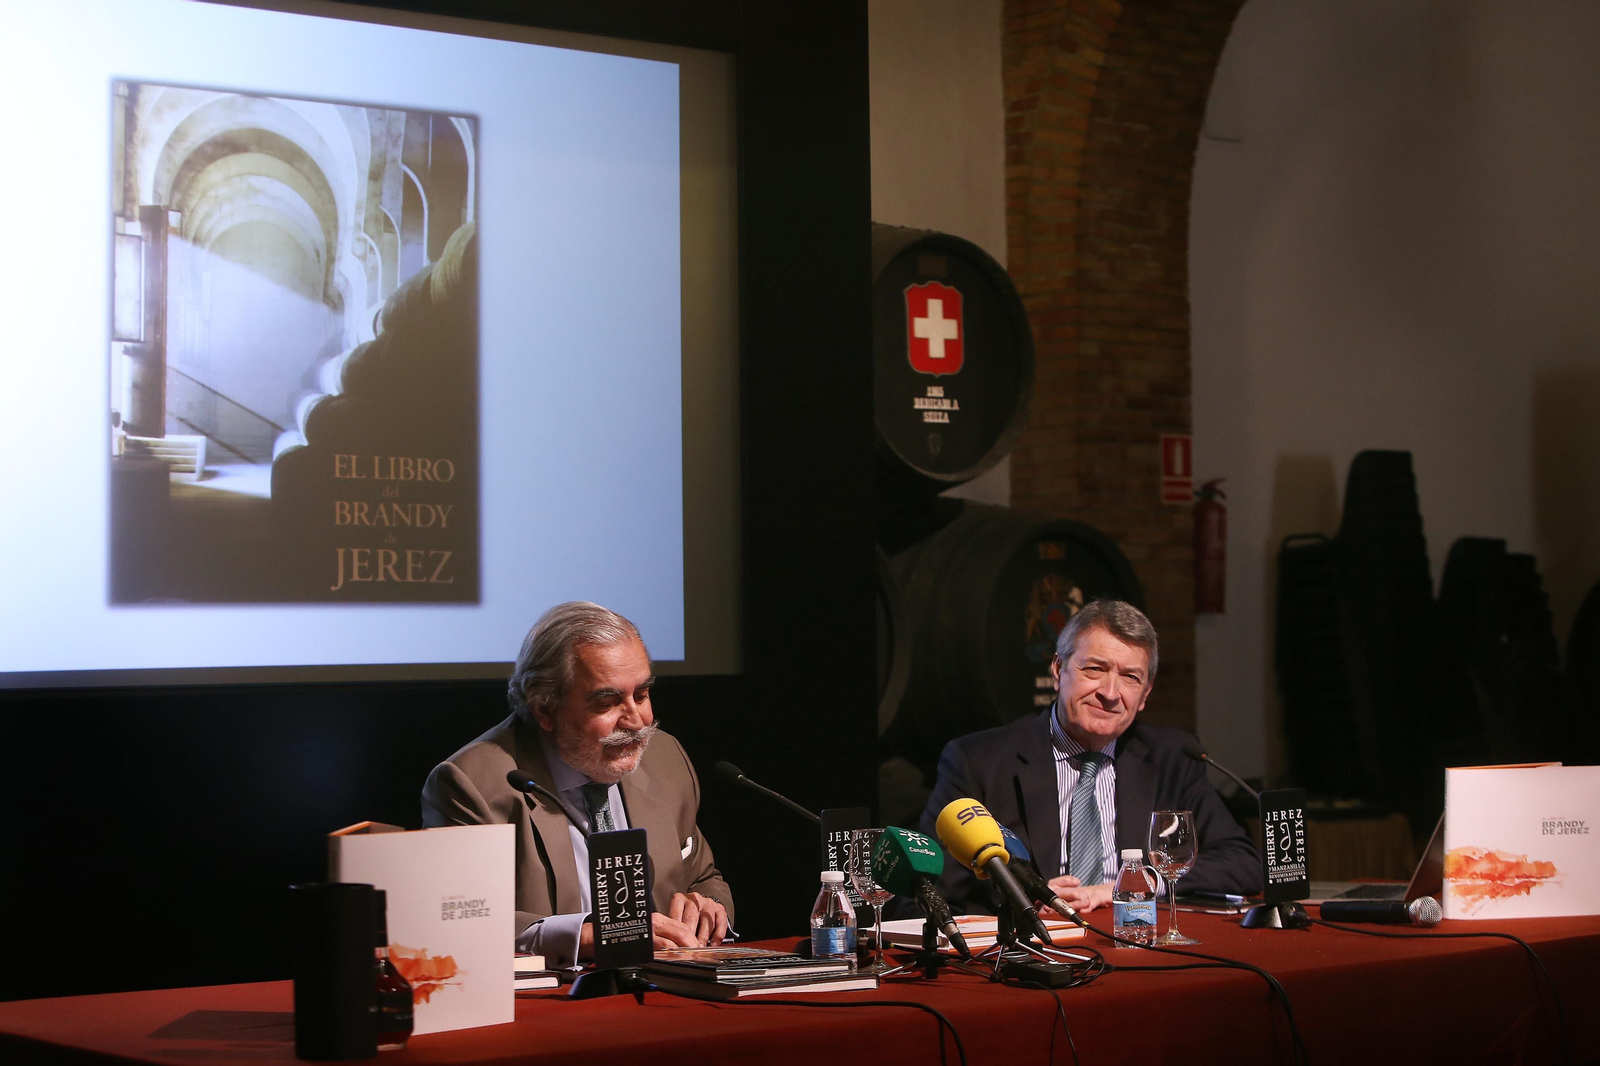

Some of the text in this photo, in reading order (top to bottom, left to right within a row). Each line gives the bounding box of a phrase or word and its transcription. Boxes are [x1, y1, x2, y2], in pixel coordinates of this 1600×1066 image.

[923, 411, 950, 423] SUIZA
[334, 454, 455, 483] EL LIBRO
[382, 486, 399, 497] del
[334, 501, 453, 528] BRANDY
[385, 532, 398, 544] de
[330, 548, 454, 591] JEREZ
[957, 805, 990, 826] SE
[1265, 808, 1303, 822] JEREZ
[1542, 820, 1585, 829] BRANDY
[1557, 827, 1590, 835] JEREZ
[1265, 822, 1276, 866] SHERRY
[1295, 819, 1305, 863] XERES
[596, 853, 643, 870] JEREZ
[828, 844, 838, 872] ERRY
[596, 872, 610, 923] SHERRY
[633, 867, 647, 918] XERES
[442, 898, 486, 911] BRANDY
[442, 908, 490, 921] DE JEREZ
[605, 918, 647, 930] MANZANILLA
